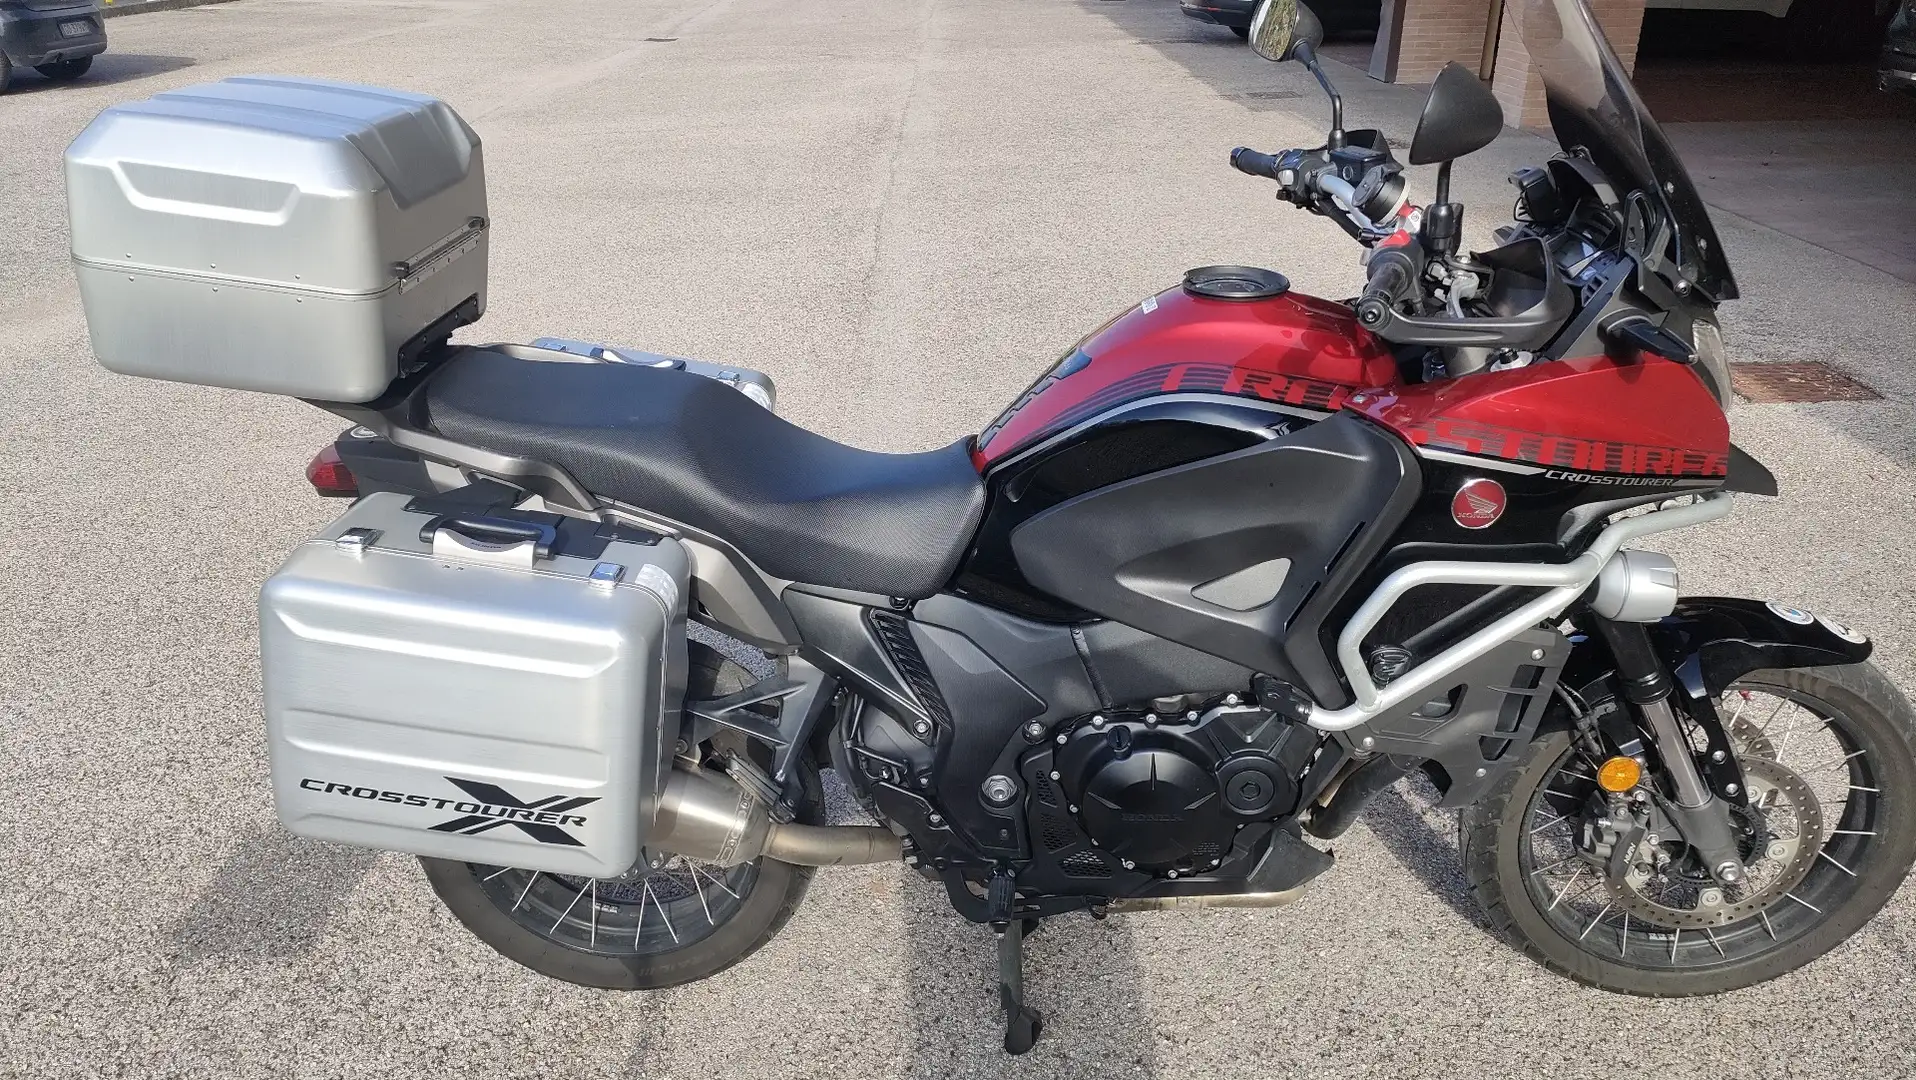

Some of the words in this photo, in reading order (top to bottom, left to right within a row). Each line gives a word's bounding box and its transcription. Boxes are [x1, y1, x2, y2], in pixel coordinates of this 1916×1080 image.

[1545, 469, 1673, 486] CROSSTOURER
[1456, 511, 1495, 519] HONDA
[300, 778, 587, 827] CROSSTOURER
